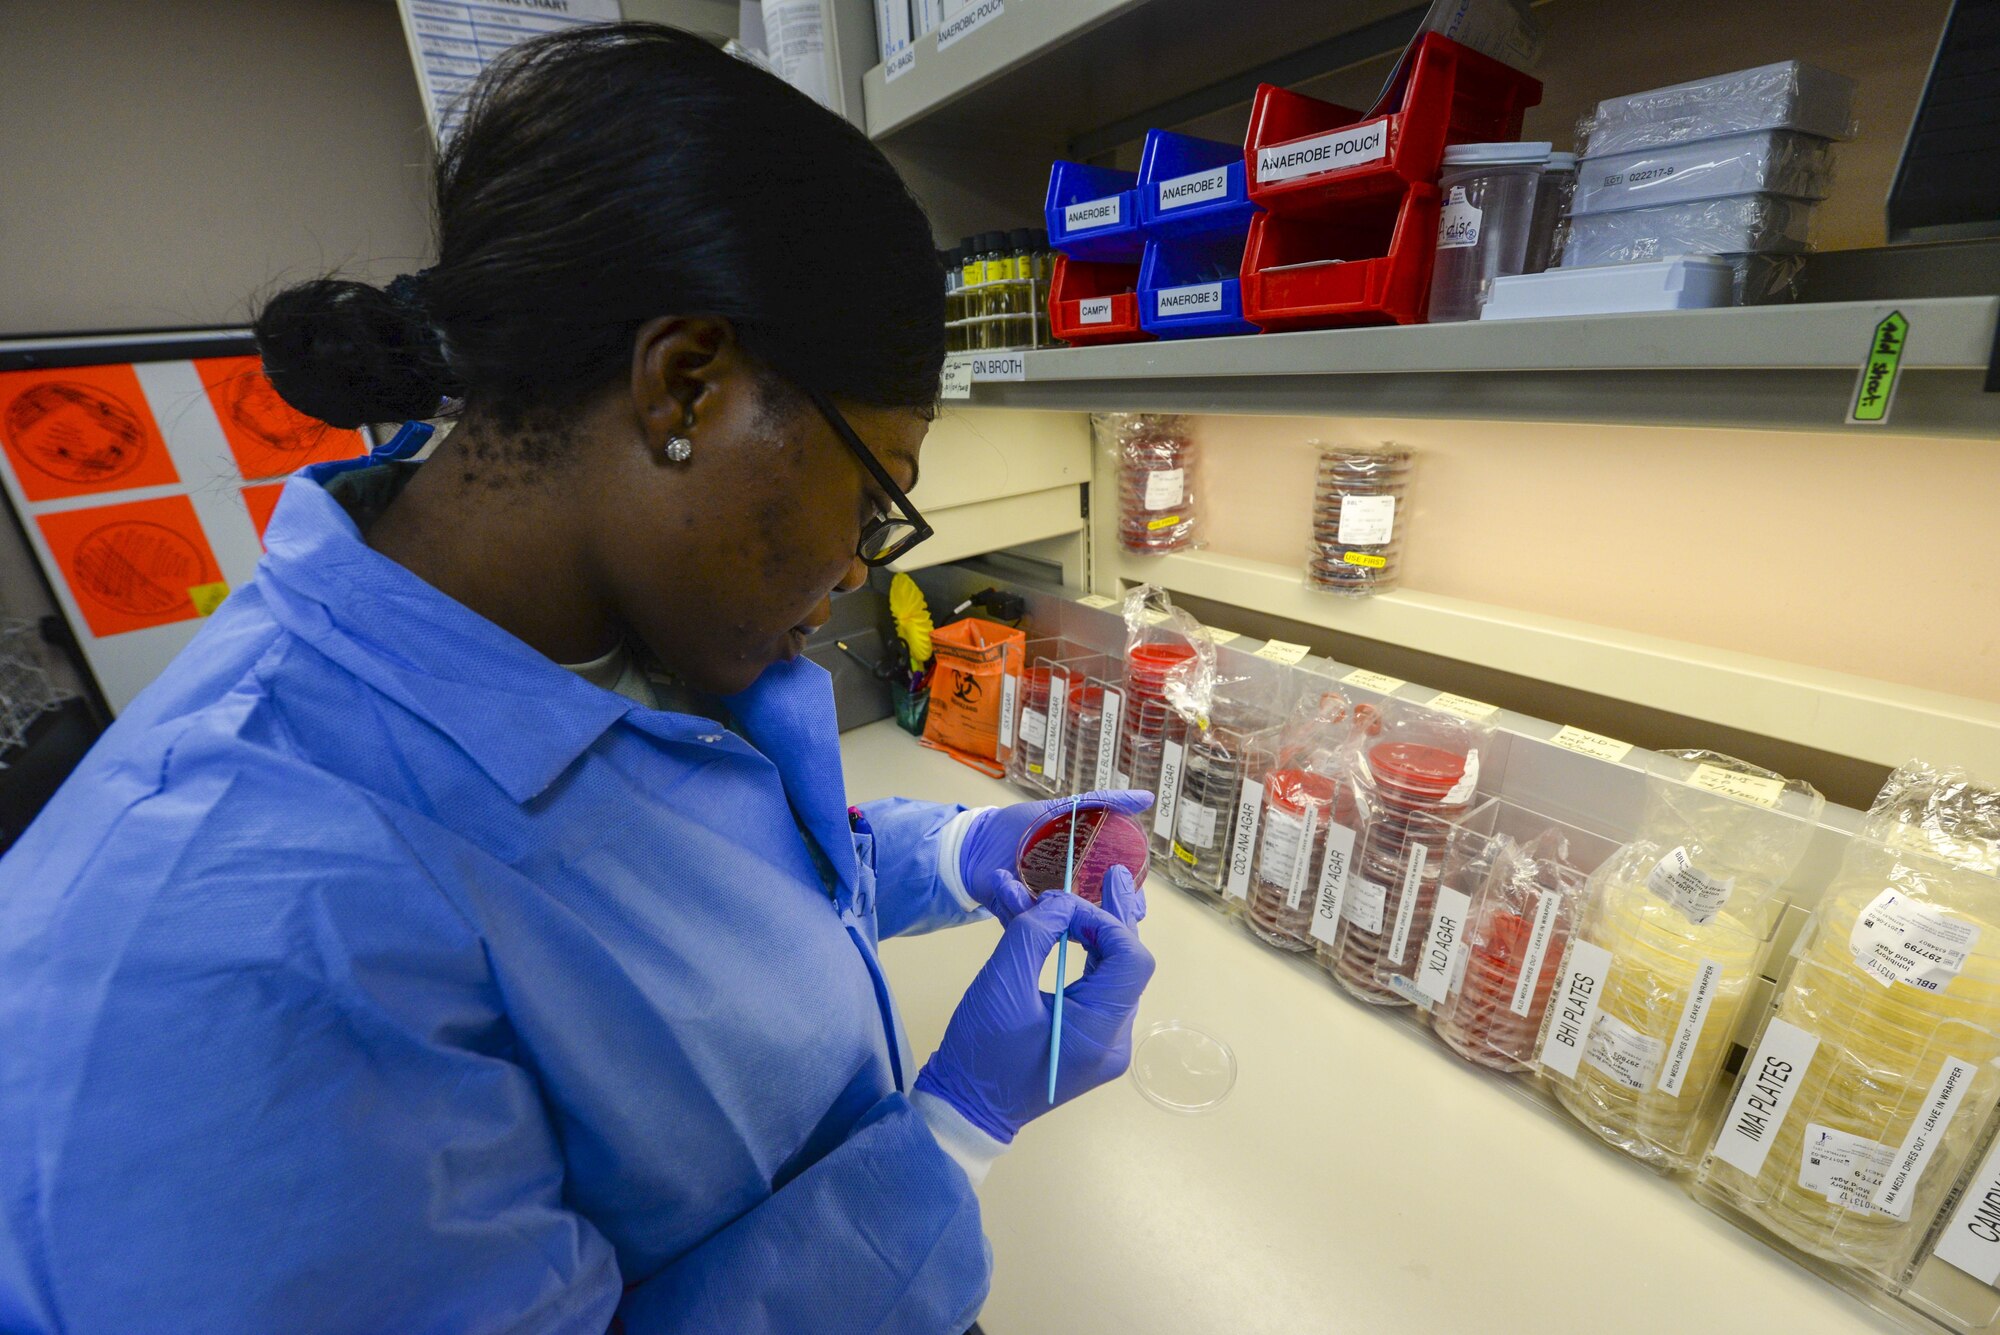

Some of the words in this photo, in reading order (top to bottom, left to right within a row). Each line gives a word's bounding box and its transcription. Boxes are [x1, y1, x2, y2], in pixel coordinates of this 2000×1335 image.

[937, 13, 976, 45] ANAEROBIC
[886, 51, 914, 77] BIO-BAGS
[1260, 146, 1332, 172] ANAEROBE
[1334, 133, 1380, 160] POUCH
[1629, 167, 1674, 182] 022217-9
[1162, 178, 1215, 201] ANAEROBE
[1216, 176, 1224, 189] 2
[1068, 206, 1110, 223] ANAEROBE
[1111, 205, 1116, 217] 1
[1081, 304, 1109, 317] CAMPY
[1160, 293, 1211, 308] ANAEROBE
[1211, 291, 1219, 302] 3
[973, 360, 986, 375] GN
[988, 359, 1022, 374] BROTH
[1345, 554, 1361, 562] USE
[1363, 557, 1385, 566] FIRST
[1050, 695, 1060, 719] AGAR
[1048, 719, 1058, 738] MAC
[1102, 711, 1114, 736] AGAR
[1046, 738, 1056, 760] BLOOD
[1099, 736, 1111, 767] BLOOD
[1096, 767, 1108, 790] HOLE
[1162, 762, 1175, 790] AGAR
[1159, 789, 1172, 817] CHOC
[1240, 801, 1254, 832] AGAR
[1236, 832, 1250, 853] ANA
[1232, 852, 1247, 875] CDC
[1327, 848, 1345, 882] AGAR
[1410, 847, 1422, 873] WRAPPER
[1318, 880, 1338, 919] CAMPY
[1540, 896, 1553, 925] WRAPPER
[1434, 914, 1457, 952] AGAR
[1533, 931, 1544, 950] LEAVE
[1528, 953, 1537, 966] OUT
[1874, 948, 1910, 972] Inhibitory
[1876, 942, 1894, 955] Agar
[1894, 953, 1916, 967] Mold
[1904, 942, 1942, 963] 297799
[1427, 948, 1448, 976] XLD
[1868, 958, 1896, 981] 013117
[1524, 965, 1534, 983] DRIES
[1697, 964, 1714, 996] WRAPPER
[1916, 977, 1938, 990] BBL
[1519, 982, 1529, 1000] MEDIA
[1562, 970, 1595, 1025] PLATES
[1687, 1002, 1701, 1023] LEAVE
[1554, 1020, 1579, 1047] BHI
[1681, 1027, 1692, 1042] OUT
[1675, 1040, 1688, 1060] DRIES
[1669, 1058, 1681, 1077] MEDIA
[1665, 1076, 1675, 1089] BHI
[1746, 1054, 1793, 1116] PLATES
[1735, 1111, 1769, 1142] IMA
[1883, 1189, 1897, 1205] IMA
[1890, 1169, 1908, 1193] MEDIA
[1900, 1149, 1919, 1173] DRIES
[1911, 1135, 1926, 1152] OUT
[1922, 1107, 1941, 1132] LEAVE
[1938, 1064, 1964, 1102] WRAPPER
